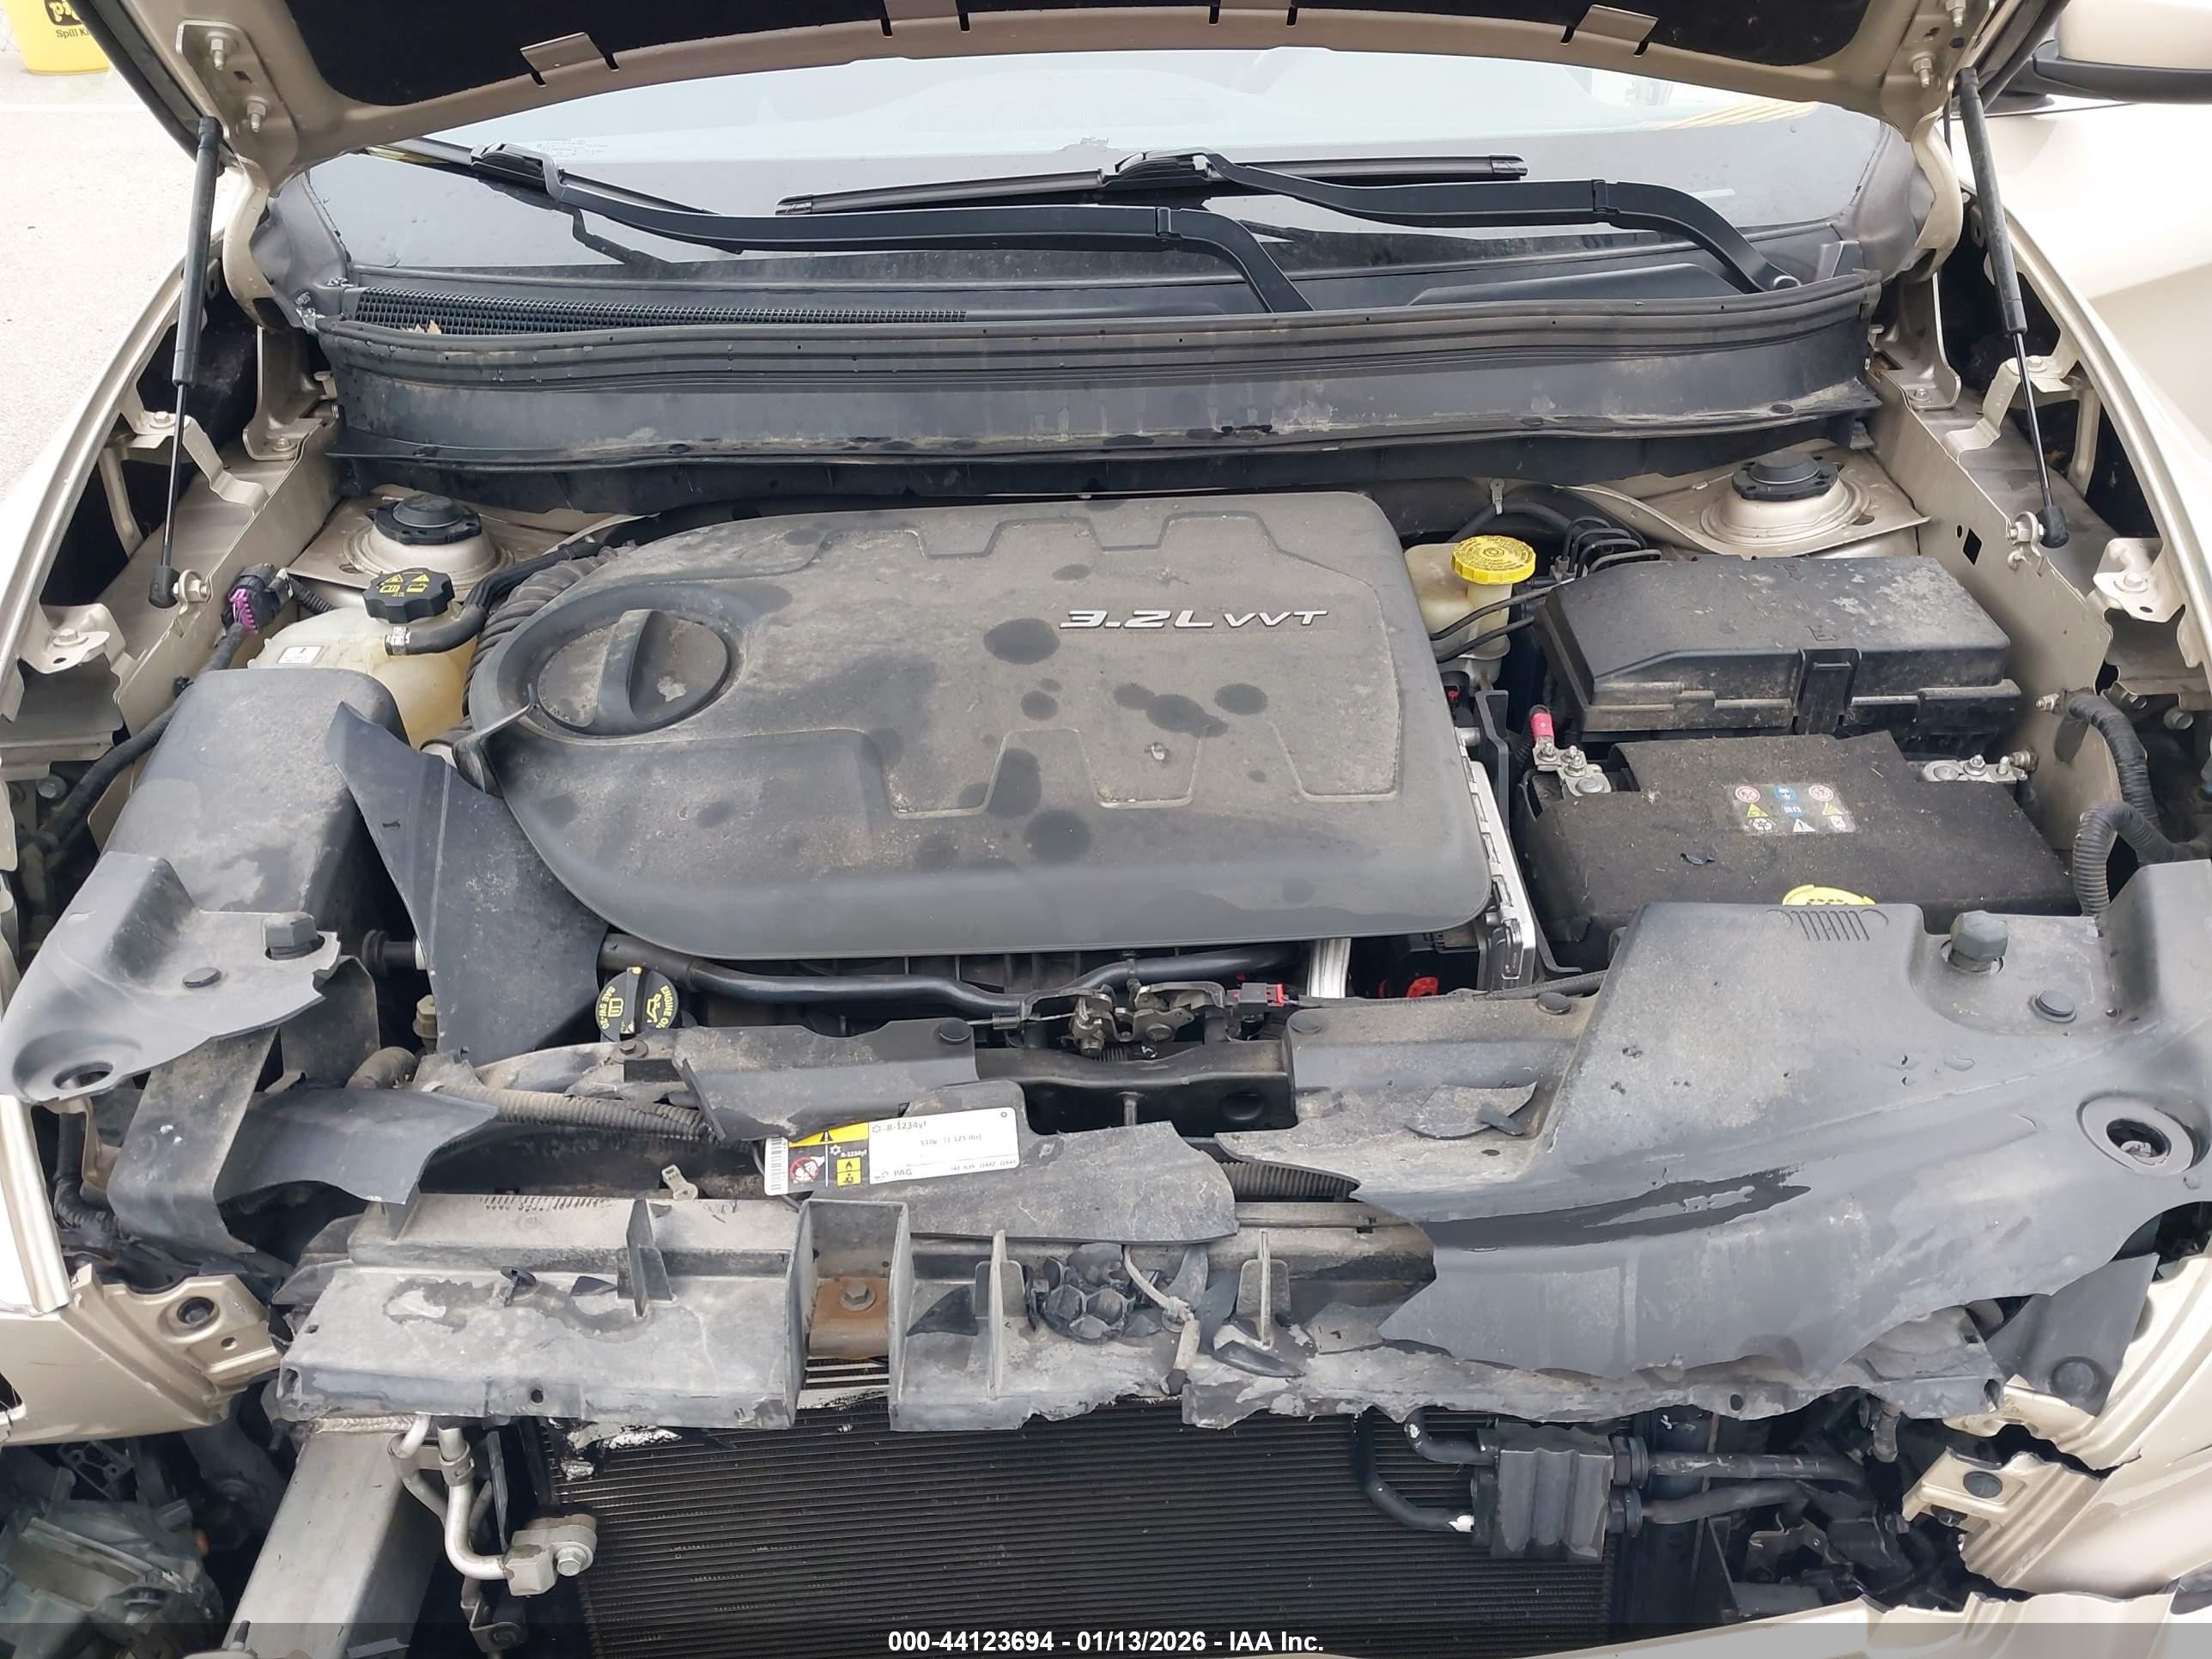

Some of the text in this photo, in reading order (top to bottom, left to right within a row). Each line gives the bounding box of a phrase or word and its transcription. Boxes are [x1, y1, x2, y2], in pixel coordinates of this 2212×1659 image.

[56, 28, 78, 39] Spill
[1059, 609, 1328, 629] 3.2L VVT
[599, 986, 616, 1030] SAE 5W-20
[659, 985, 674, 1017] ENGINE
[894, 1168, 912, 1176] PAG
